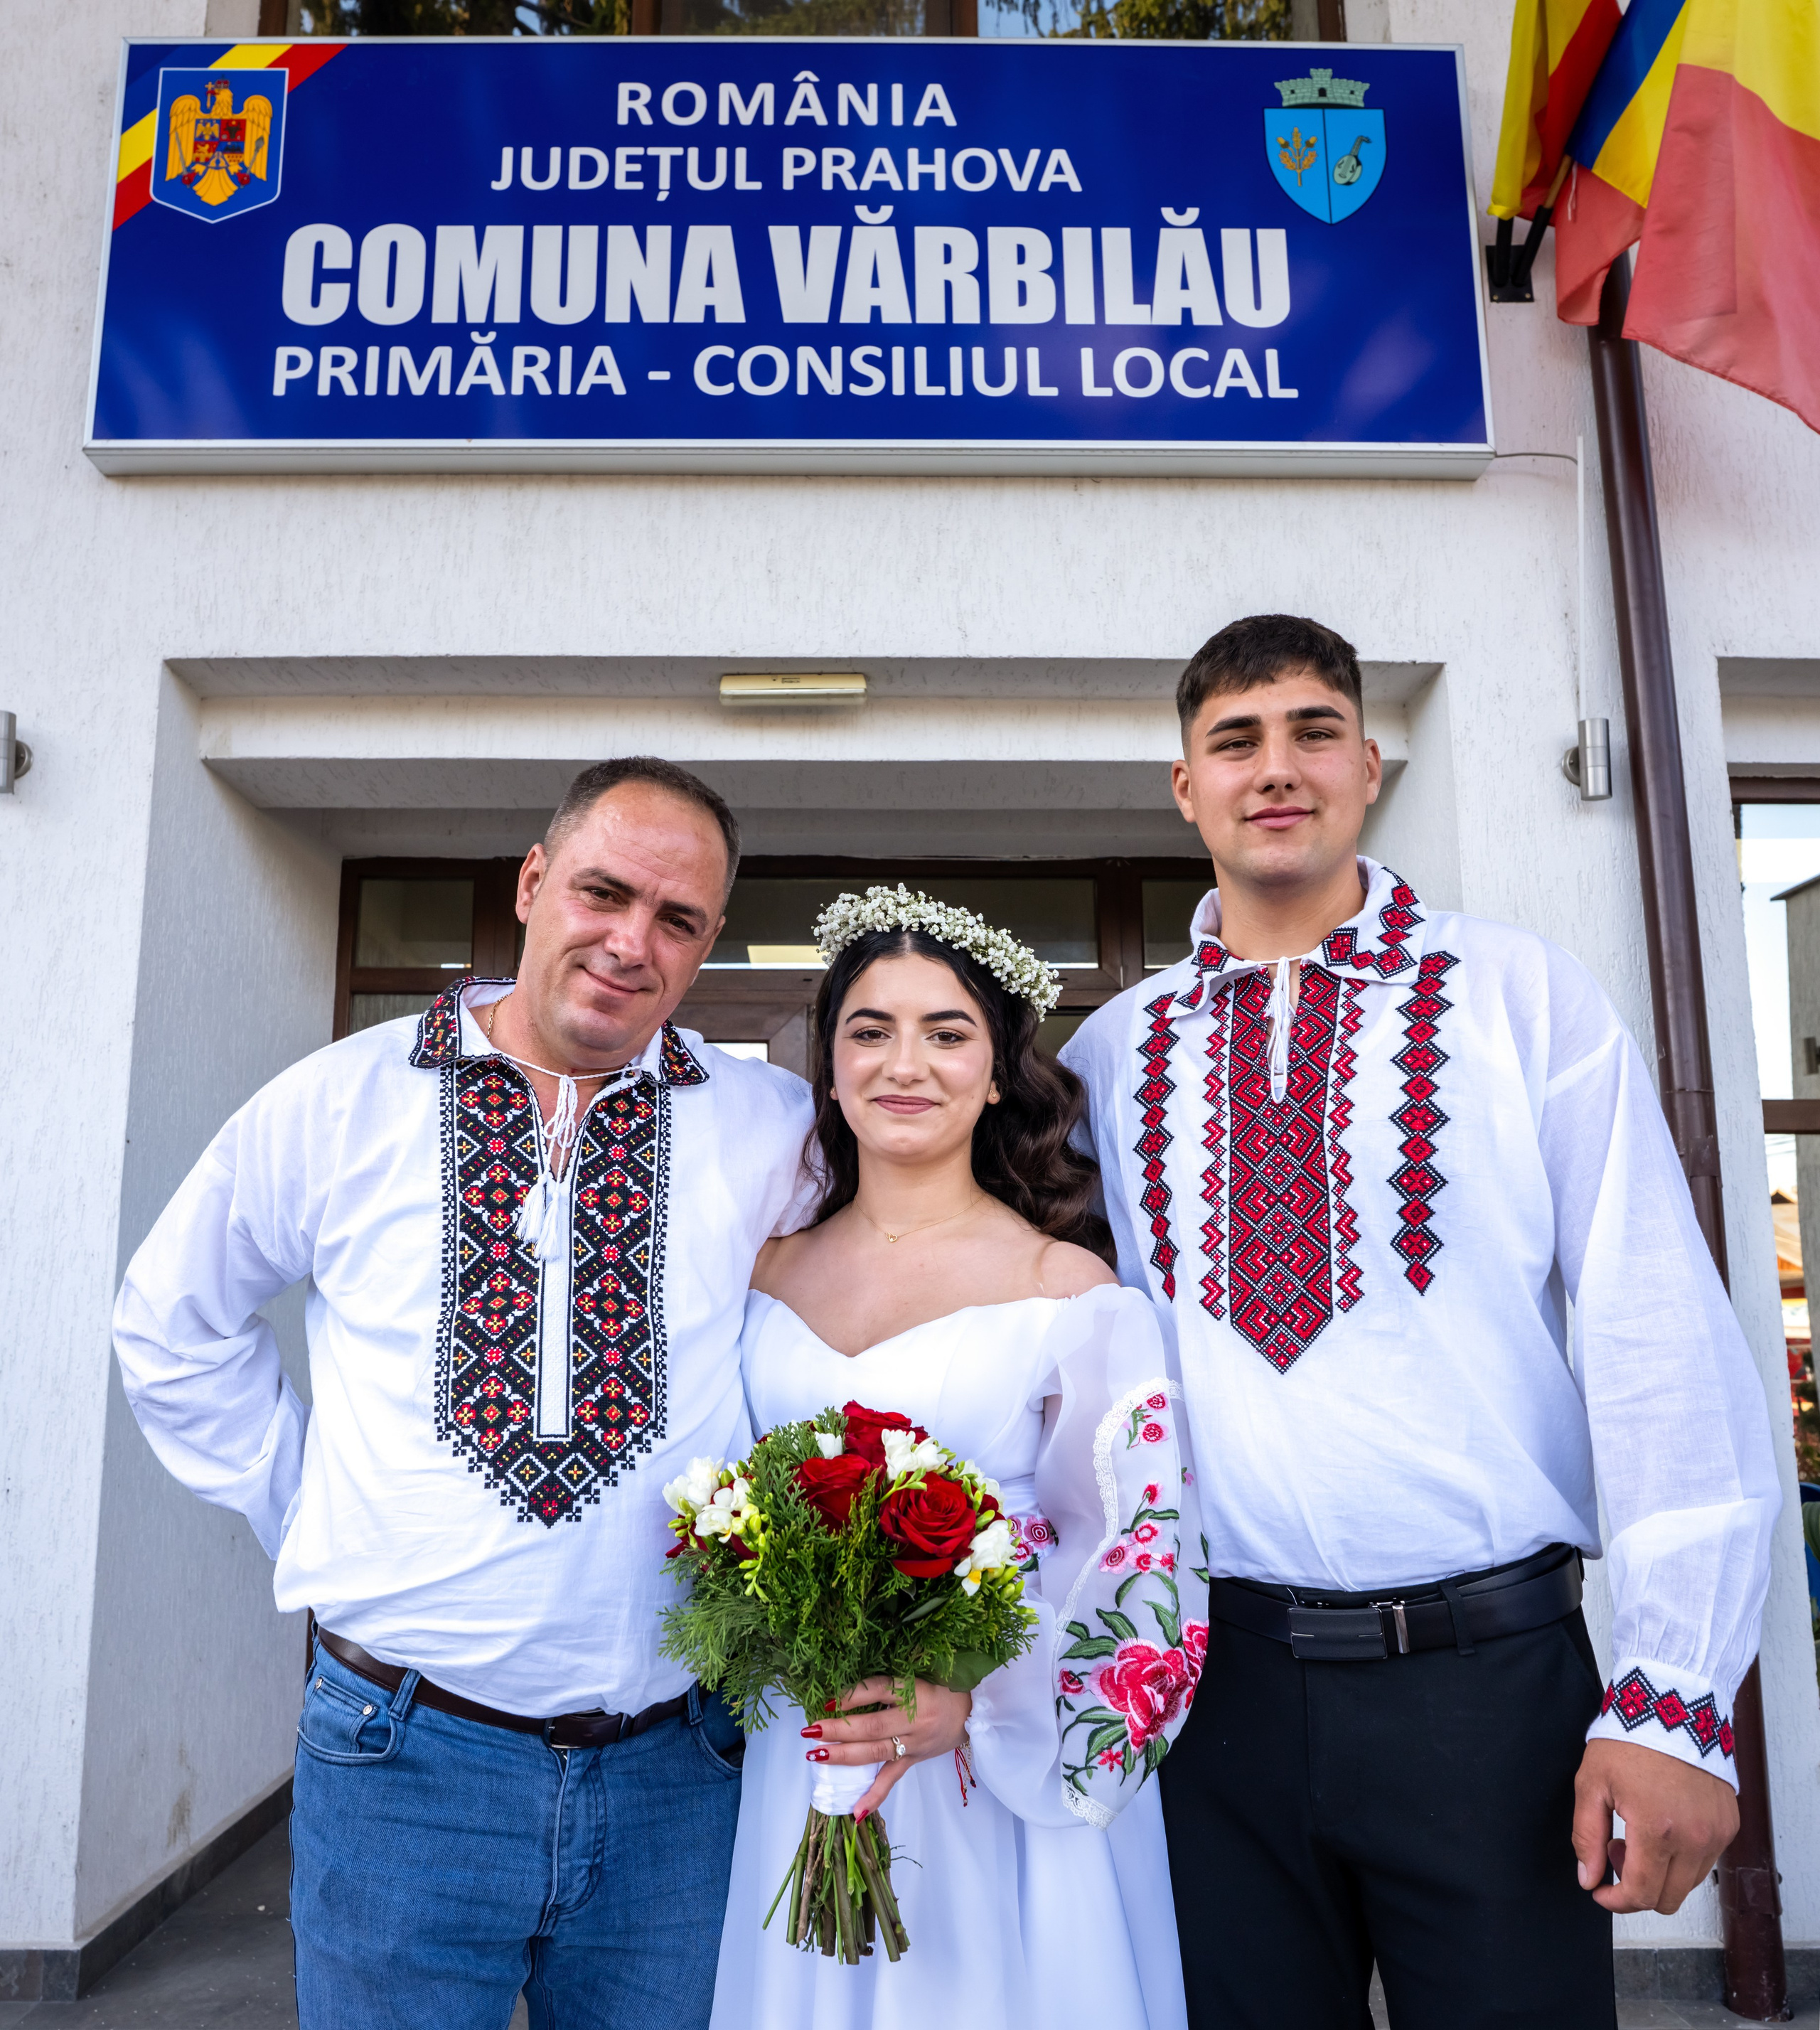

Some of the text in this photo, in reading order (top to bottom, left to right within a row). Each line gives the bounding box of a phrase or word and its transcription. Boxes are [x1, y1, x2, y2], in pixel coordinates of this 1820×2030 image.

[617, 70, 958, 127] ROMÂNIA
[782, 147, 1083, 192] PRAHOVA
[282, 205, 1291, 328] COMUNA VĂRBILĂU
[272, 331, 1298, 398] PRIMĂRIA - CONSILIUL LOCAL
